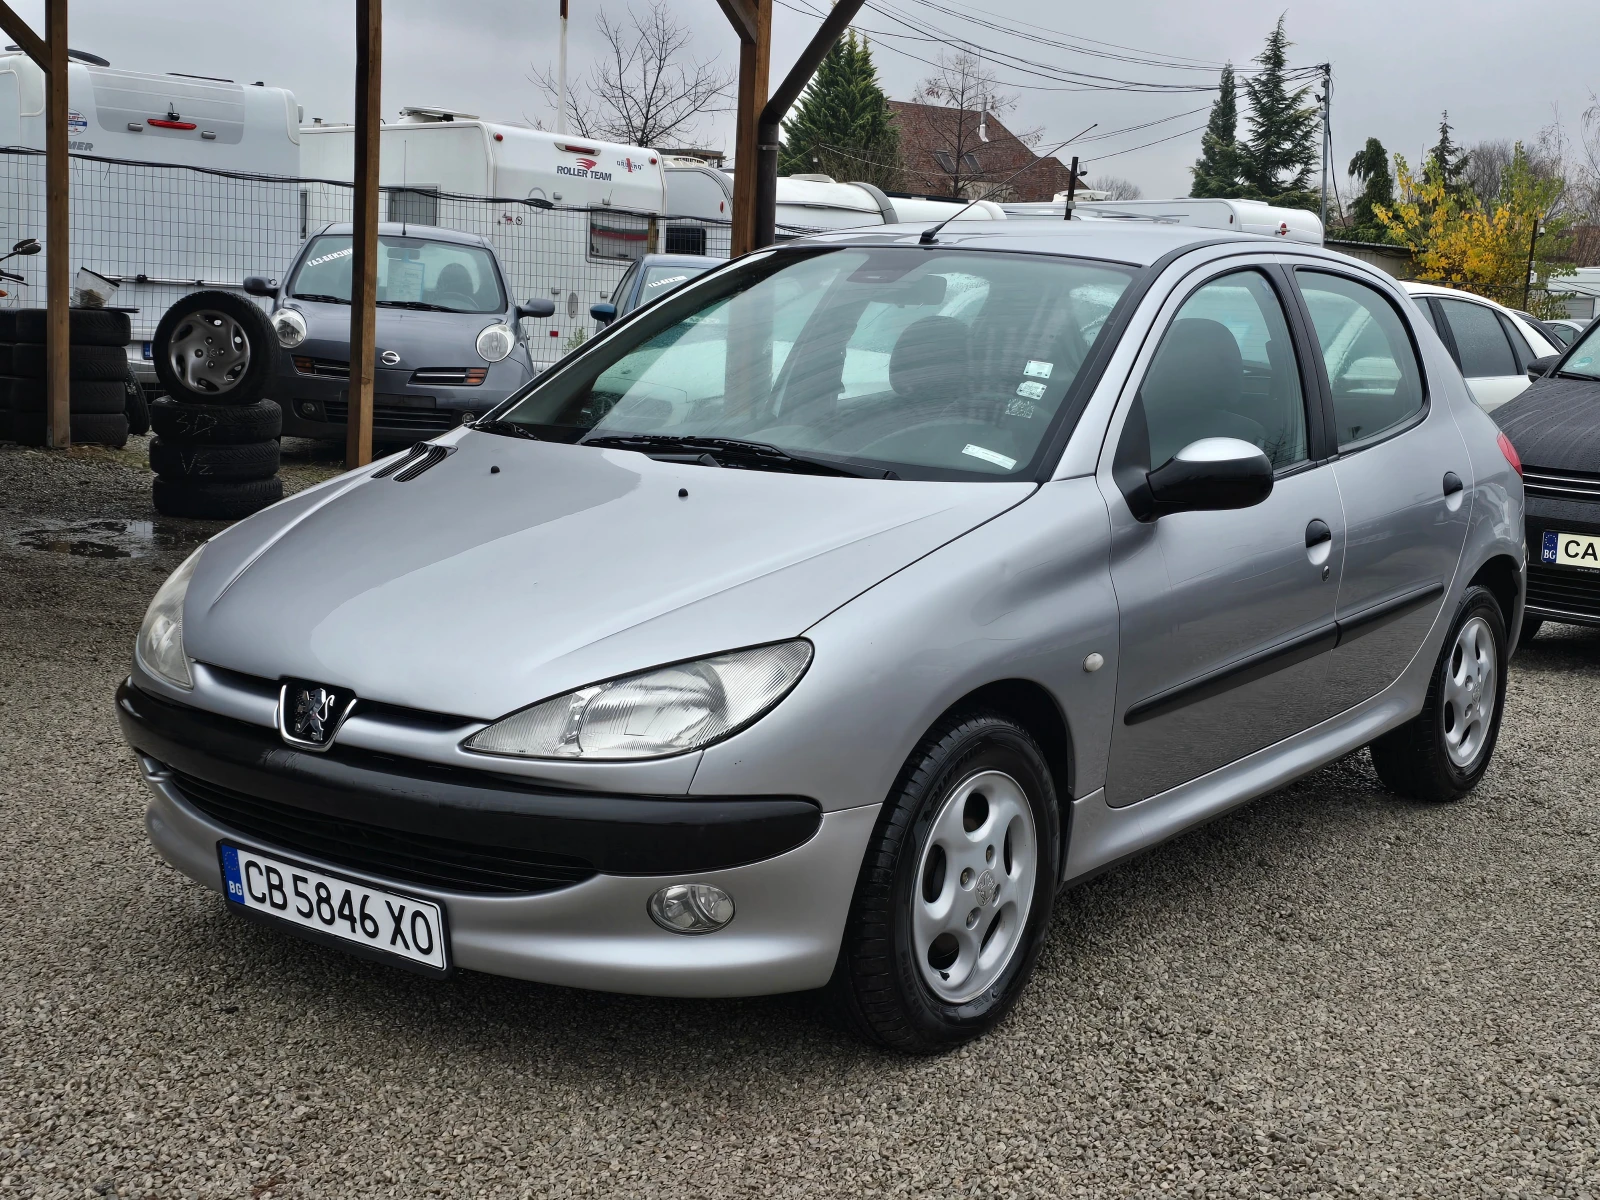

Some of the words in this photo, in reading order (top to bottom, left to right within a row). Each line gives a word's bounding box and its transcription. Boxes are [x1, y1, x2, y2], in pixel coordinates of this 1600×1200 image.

[557, 166, 588, 178] ROLLER
[590, 170, 612, 181] TEAM
[1544, 549, 1556, 560] BG
[1564, 540, 1599, 562] CA
[228, 880, 243, 896] BG
[244, 860, 288, 910] CB
[292, 873, 380, 939] 5846
[384, 899, 434, 955] XO
